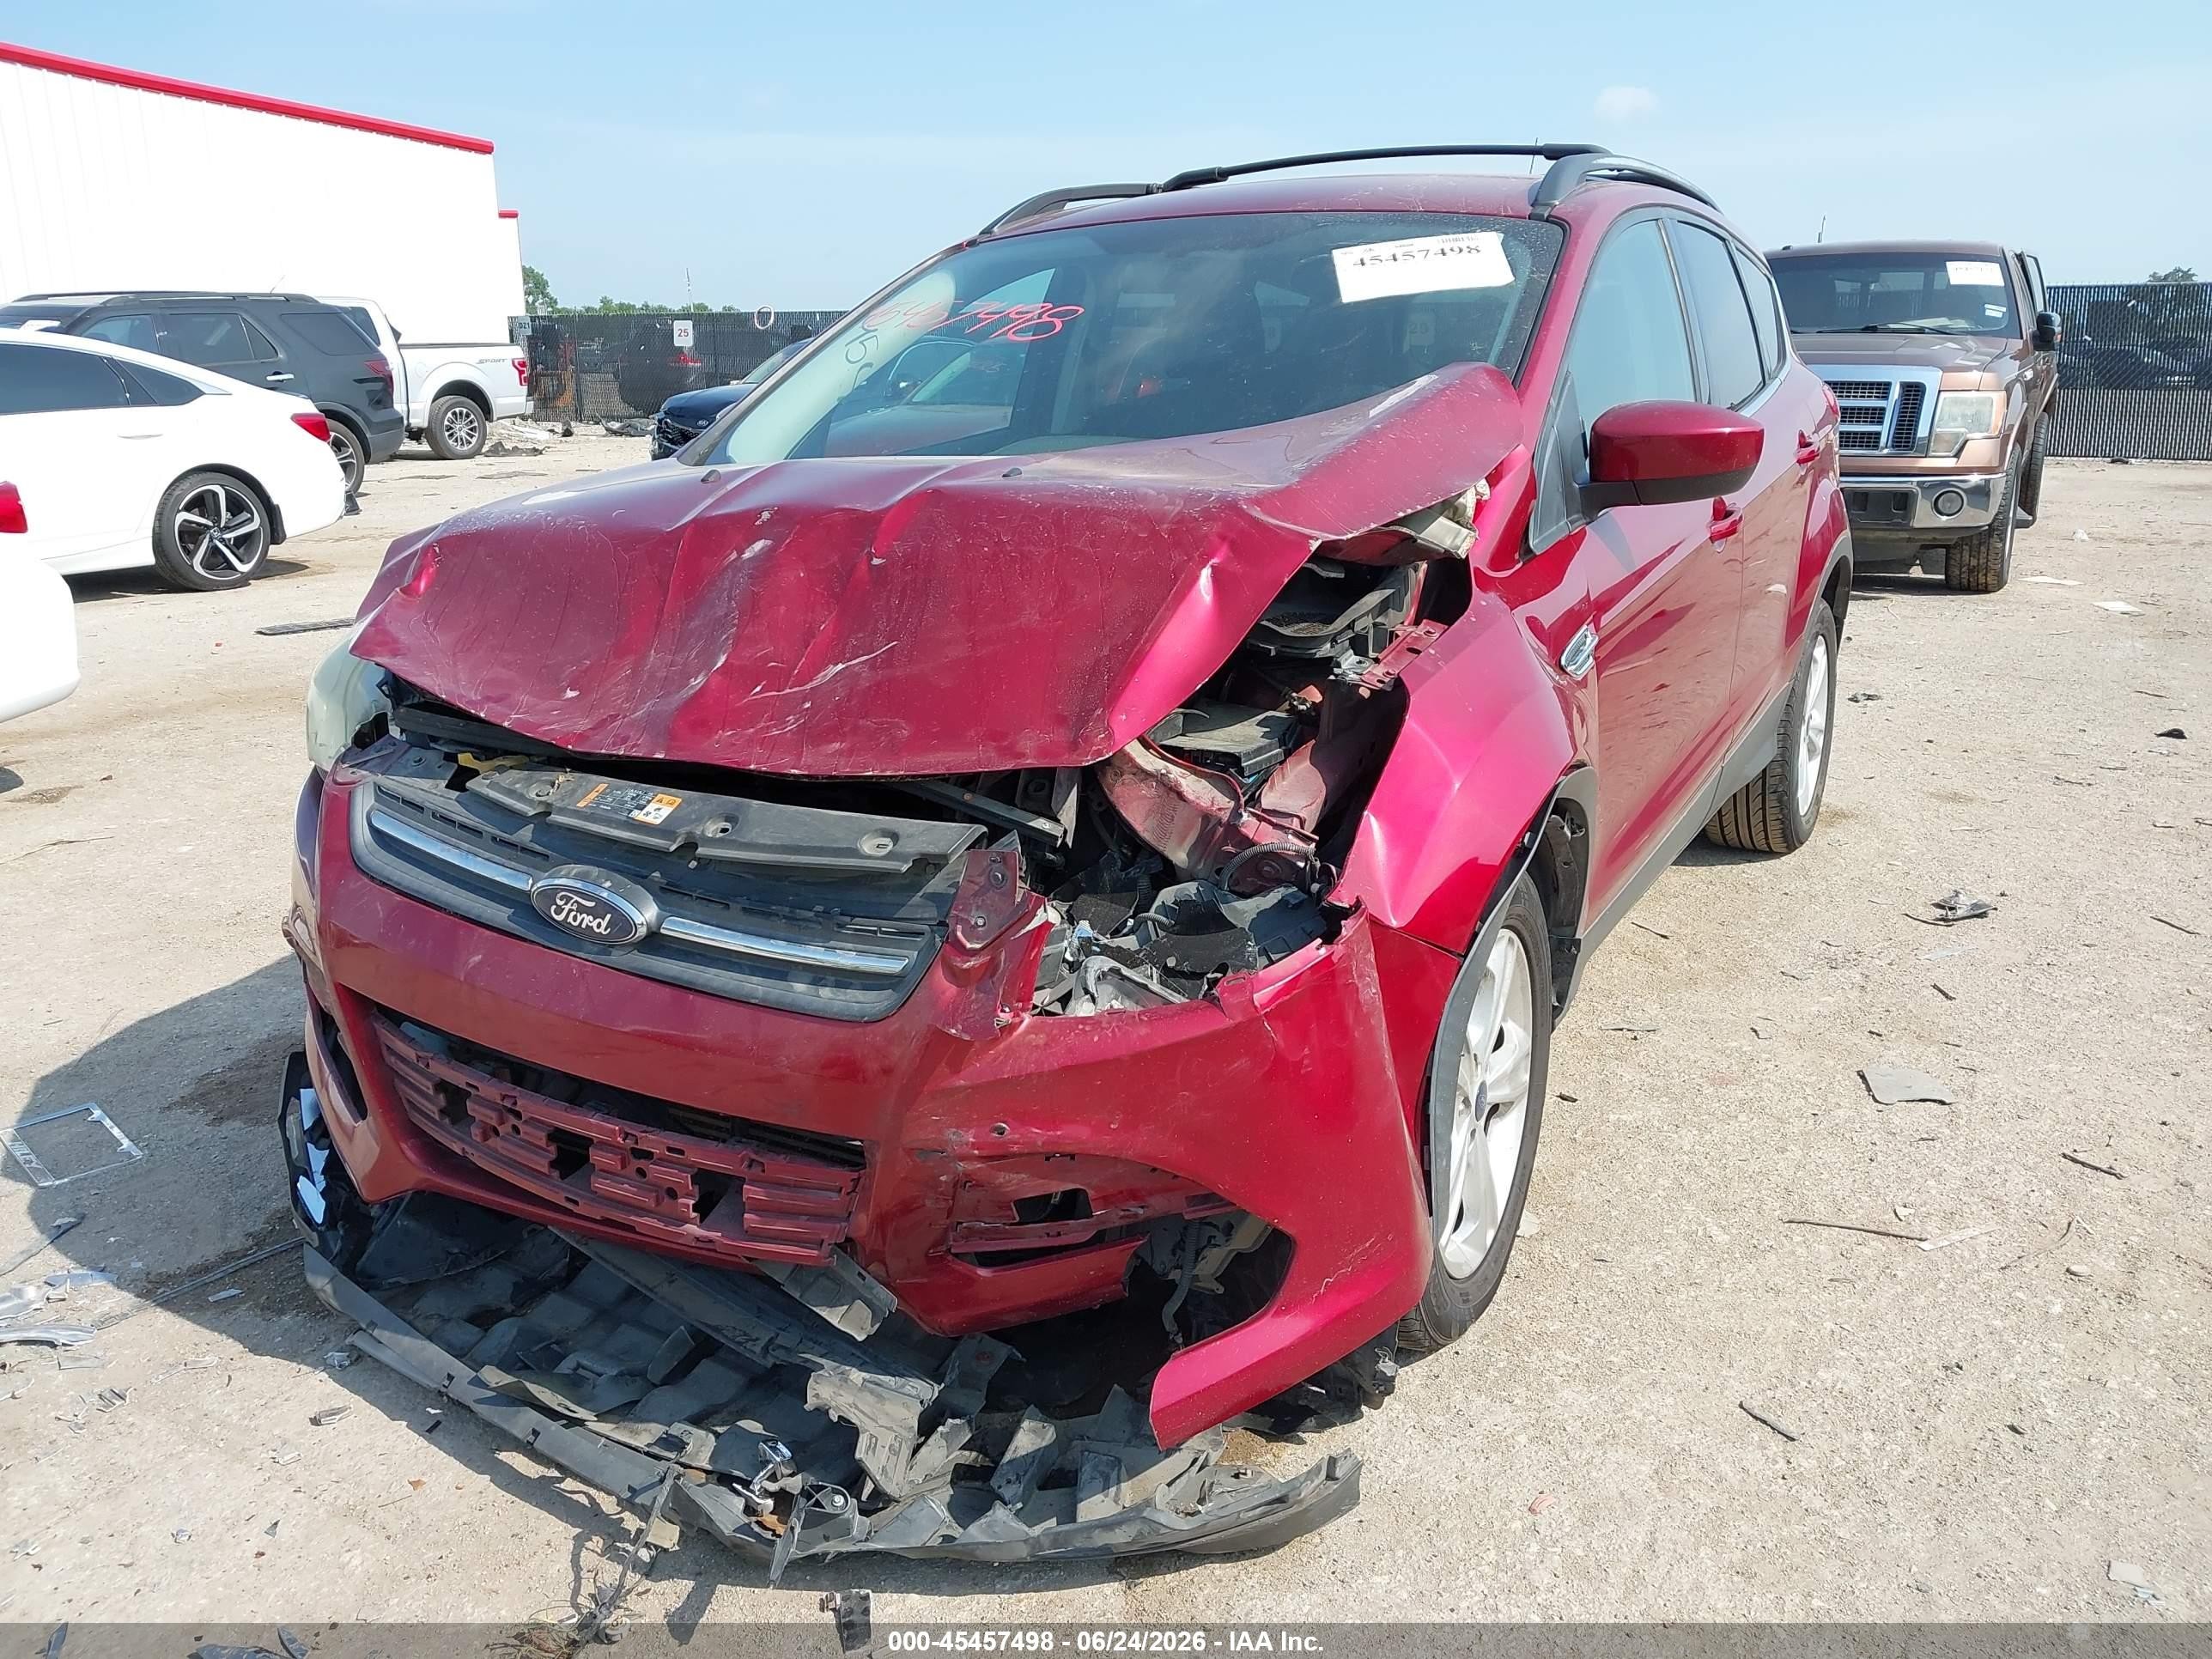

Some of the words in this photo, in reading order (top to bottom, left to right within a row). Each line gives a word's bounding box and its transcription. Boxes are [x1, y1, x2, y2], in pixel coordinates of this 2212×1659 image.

[1352, 244, 1482, 267] 45457498
[677, 328, 690, 337] 25
[550, 891, 612, 935] Ford
